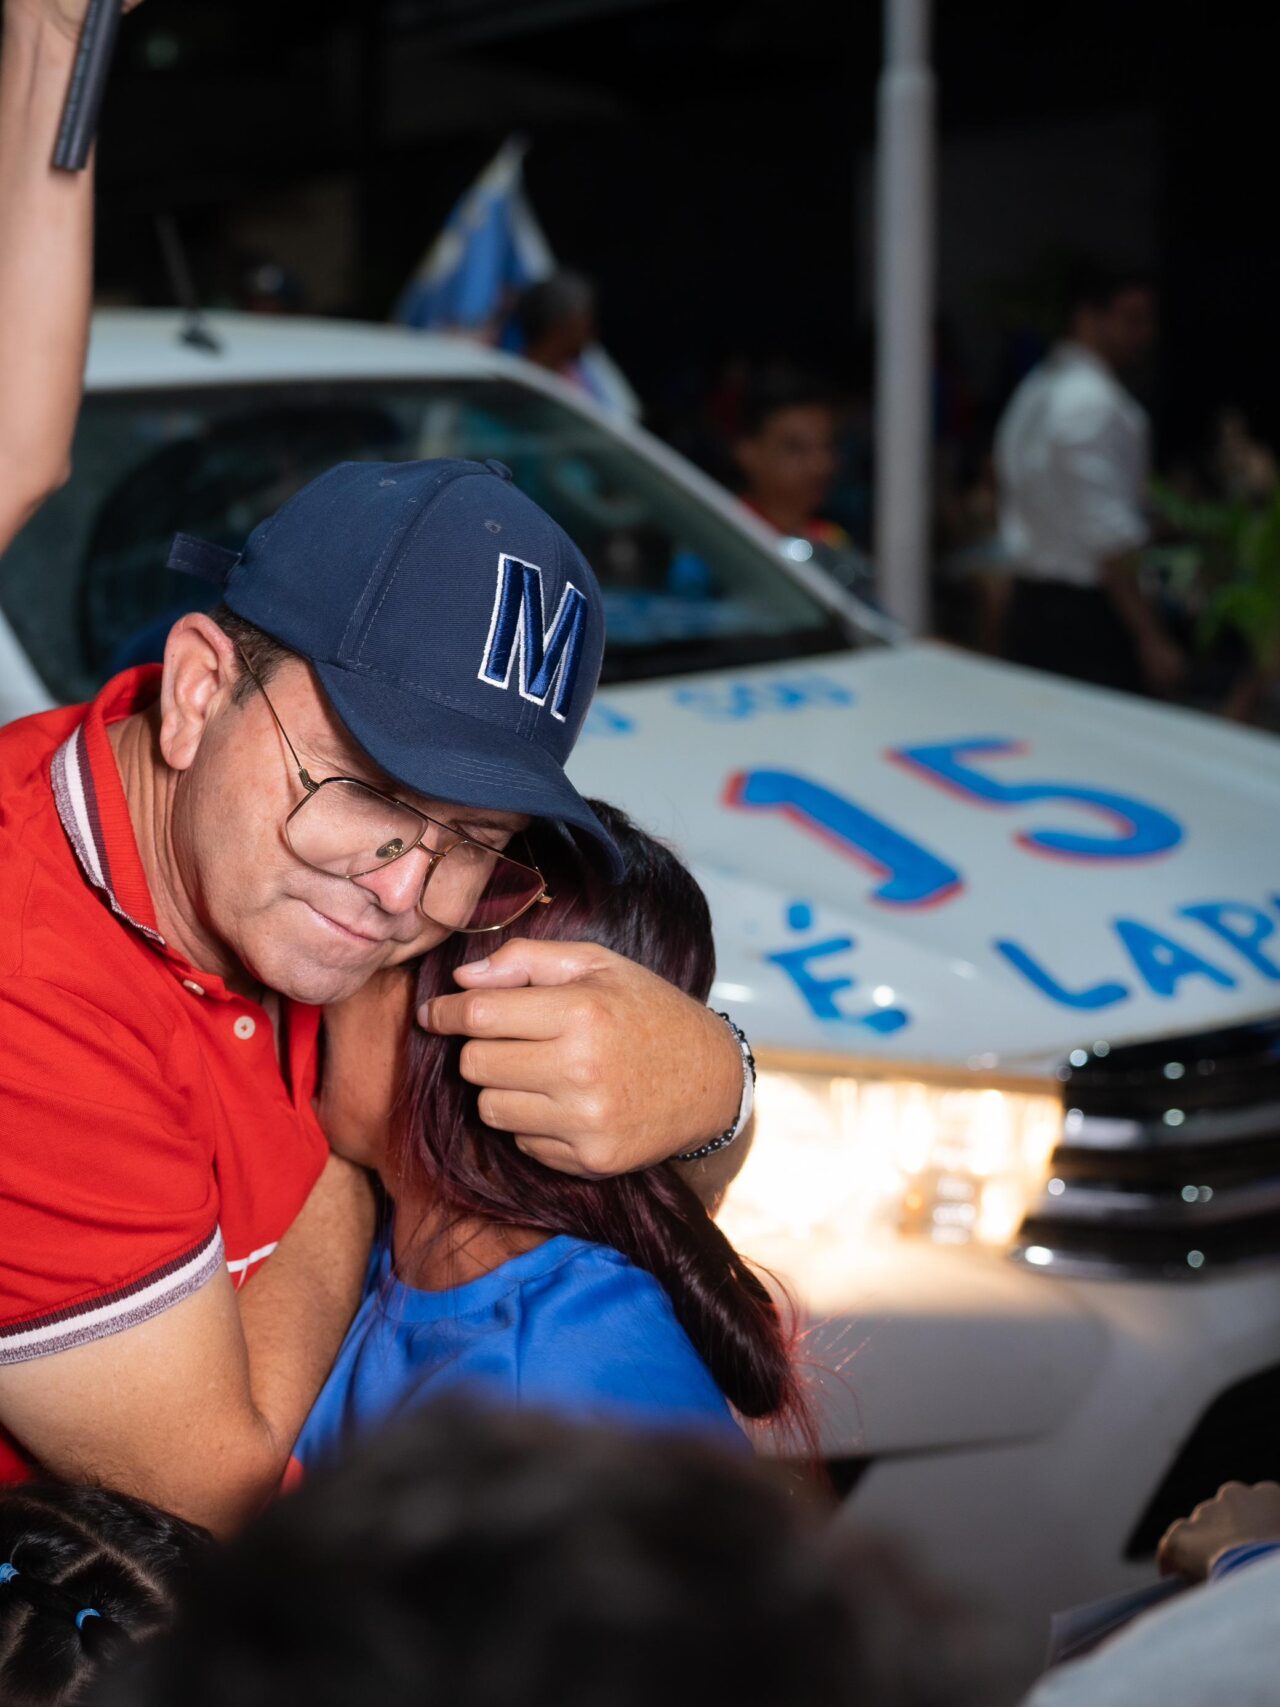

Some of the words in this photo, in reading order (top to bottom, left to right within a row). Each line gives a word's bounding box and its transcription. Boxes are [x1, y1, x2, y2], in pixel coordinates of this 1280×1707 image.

[477, 552, 588, 723] M
[724, 736, 1186, 911] 15
[990, 890, 1280, 1012] LAP
